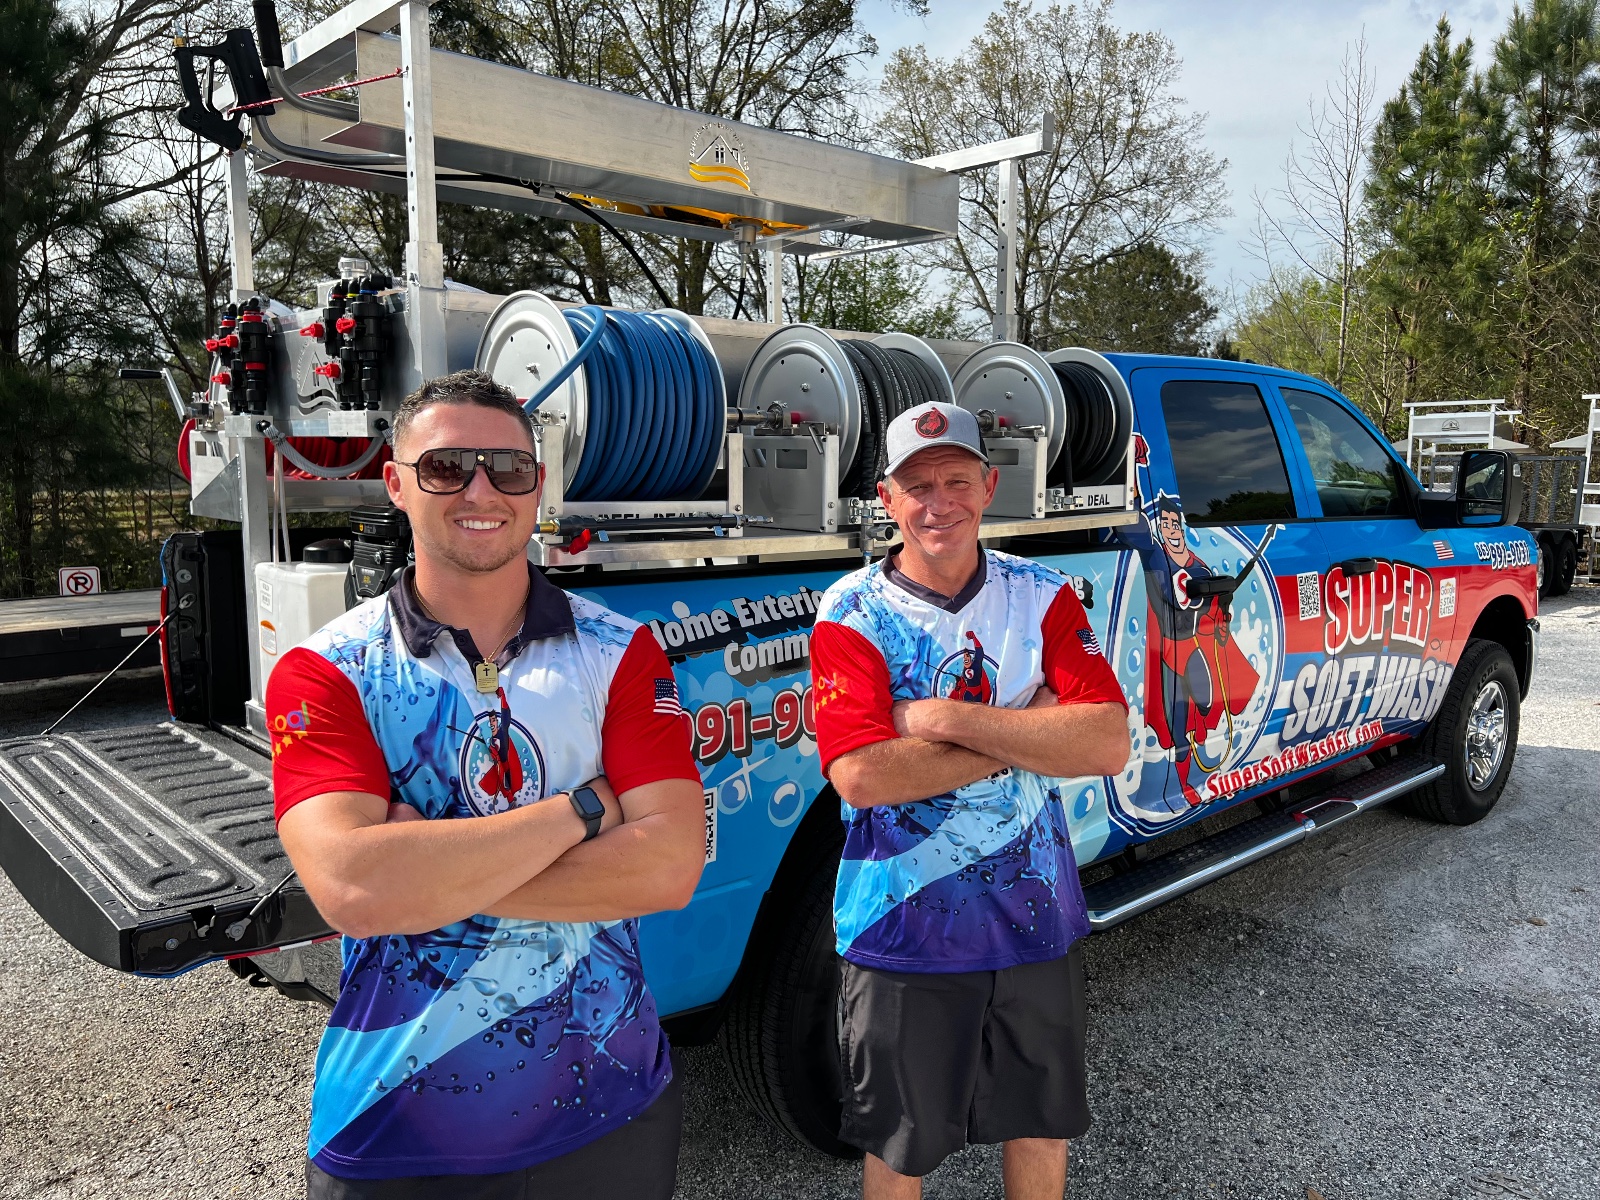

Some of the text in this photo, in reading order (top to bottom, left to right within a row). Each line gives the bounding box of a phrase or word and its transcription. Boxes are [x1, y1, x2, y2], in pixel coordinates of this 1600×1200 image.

[1087, 494, 1110, 507] DEAL
[731, 585, 826, 628] Exterio
[1325, 561, 1433, 655] SUPER
[724, 632, 811, 676] Comm
[1282, 654, 1454, 741] SOFT WASH
